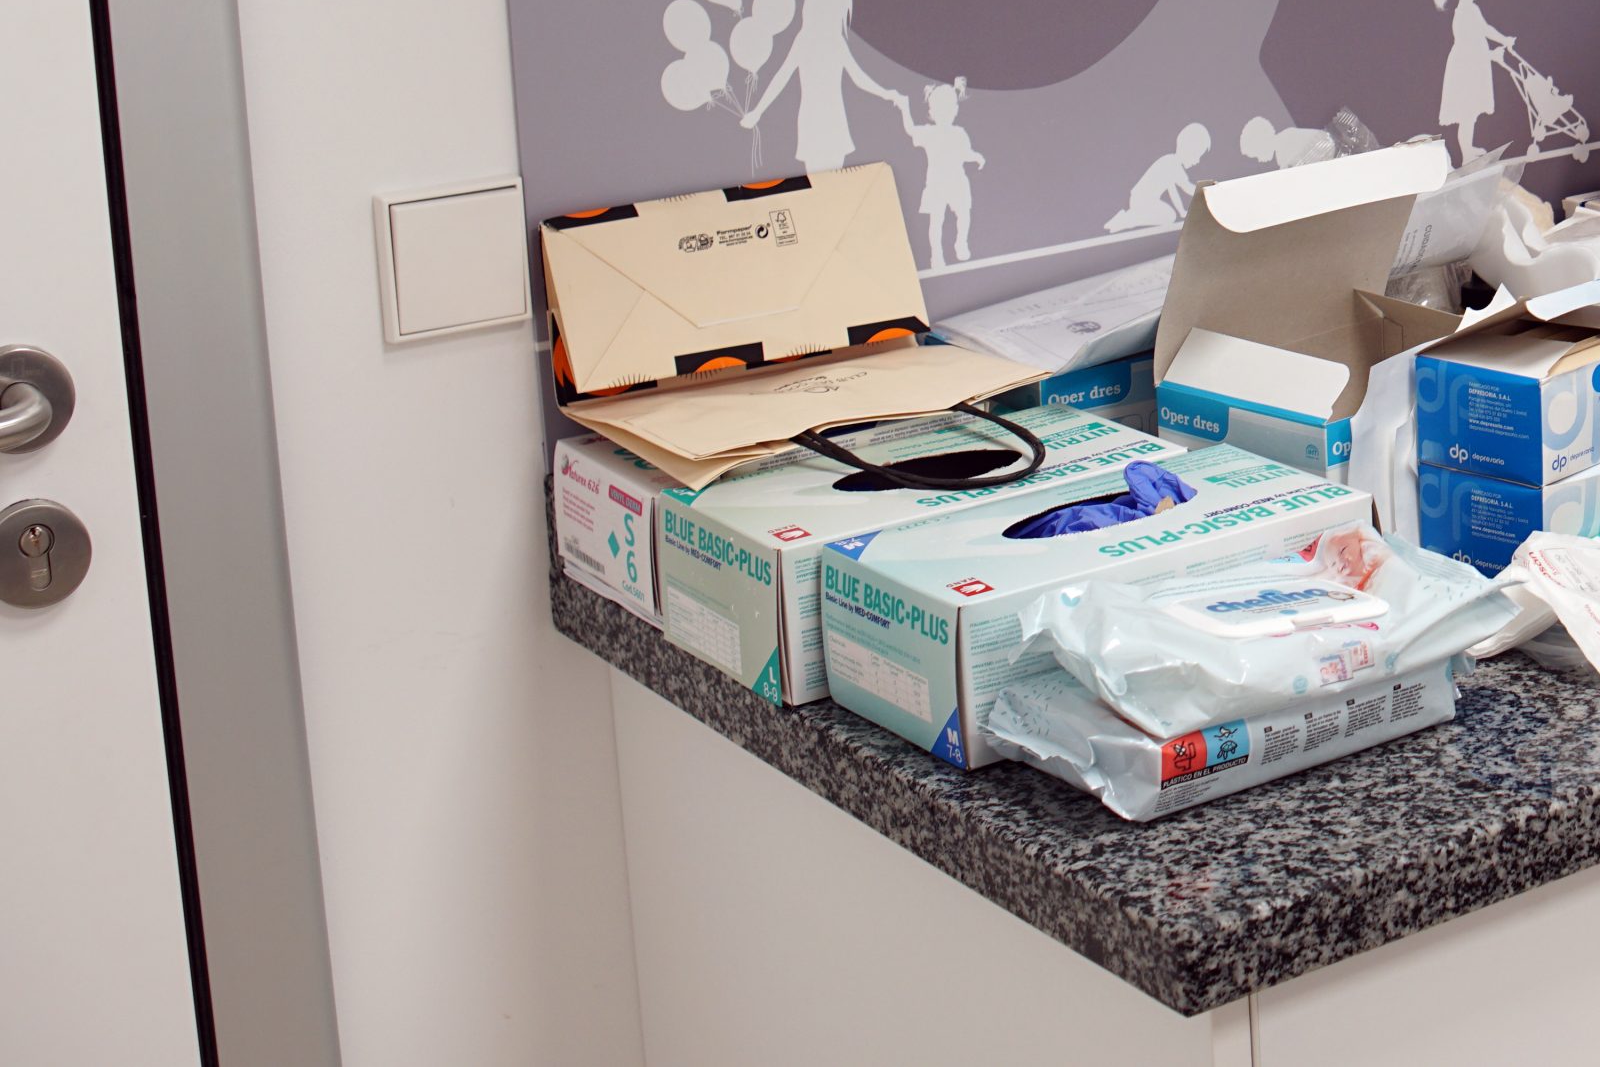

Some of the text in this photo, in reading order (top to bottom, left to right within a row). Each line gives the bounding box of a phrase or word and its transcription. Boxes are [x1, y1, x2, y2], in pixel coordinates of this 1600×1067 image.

[1048, 384, 1121, 406] Oper dres
[1160, 406, 1220, 434] Oper dres
[1050, 427, 1120, 451] NITRIL
[1093, 442, 1167, 466] BLUE
[1449, 443, 1505, 465] dp depresoria
[1551, 454, 1567, 472] dp
[587, 479, 600, 495] 626
[1216, 467, 1301, 489] NITRIL
[1203, 495, 1274, 519] MED-COMFORT
[623, 513, 635, 548] S
[664, 509, 695, 546] BLUE
[1099, 485, 1353, 558] BLUE BASIC-PLUS
[626, 550, 638, 583] 6
[825, 564, 860, 603] BLUE
[825, 591, 838, 605] Basic
[838, 597, 848, 609] Line
[1206, 588, 1329, 613] chelino
[768, 666, 777, 684] L
[763, 681, 778, 702] 8-9
[946, 727, 959, 745] M
[946, 743, 962, 764] 7-8
[1193, 757, 1248, 780] EN EL PRODUCTO
